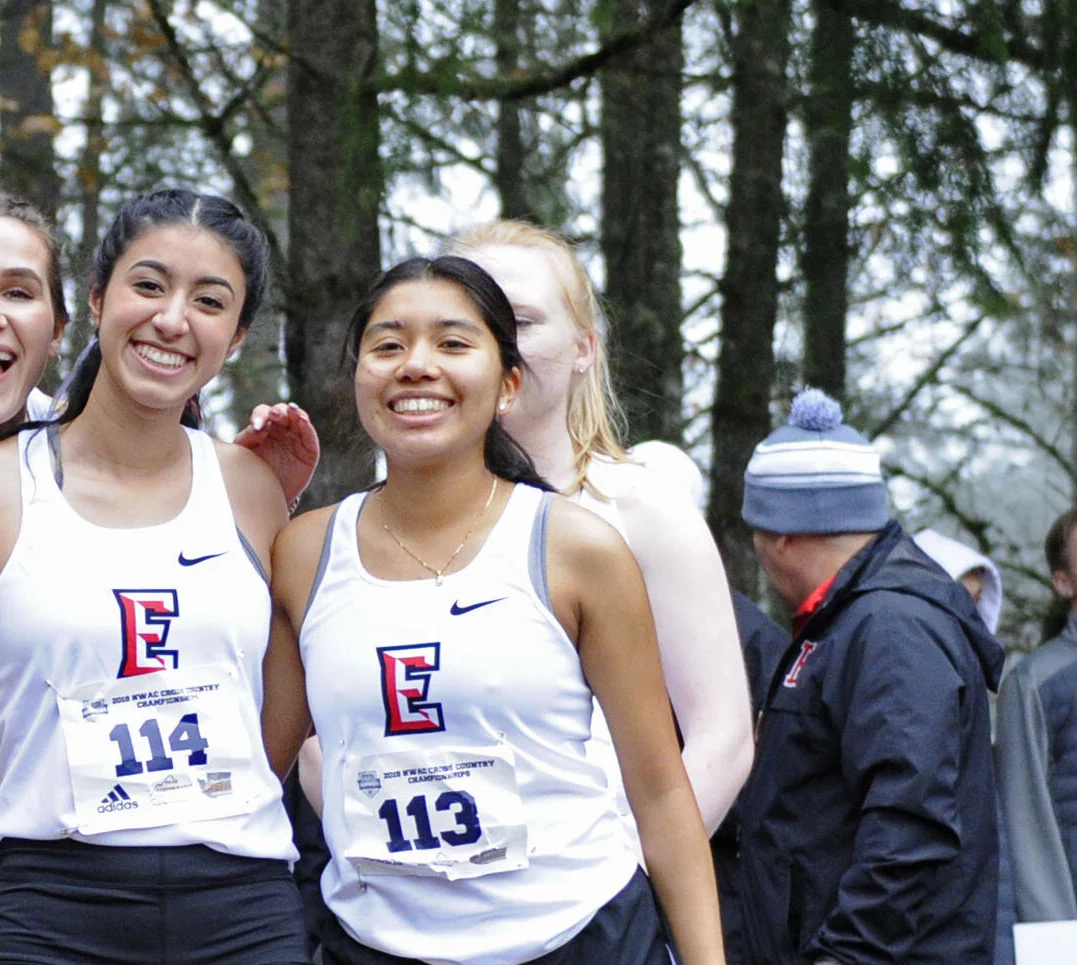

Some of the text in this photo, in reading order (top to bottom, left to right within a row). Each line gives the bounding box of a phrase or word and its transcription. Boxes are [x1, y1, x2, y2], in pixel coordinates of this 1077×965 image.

[111, 589, 180, 679] E
[376, 642, 446, 737] E
[109, 713, 209, 777] 114
[455, 759, 495, 770] COUNTRY
[97, 799, 139, 814] adidas
[378, 790, 482, 853] 113
